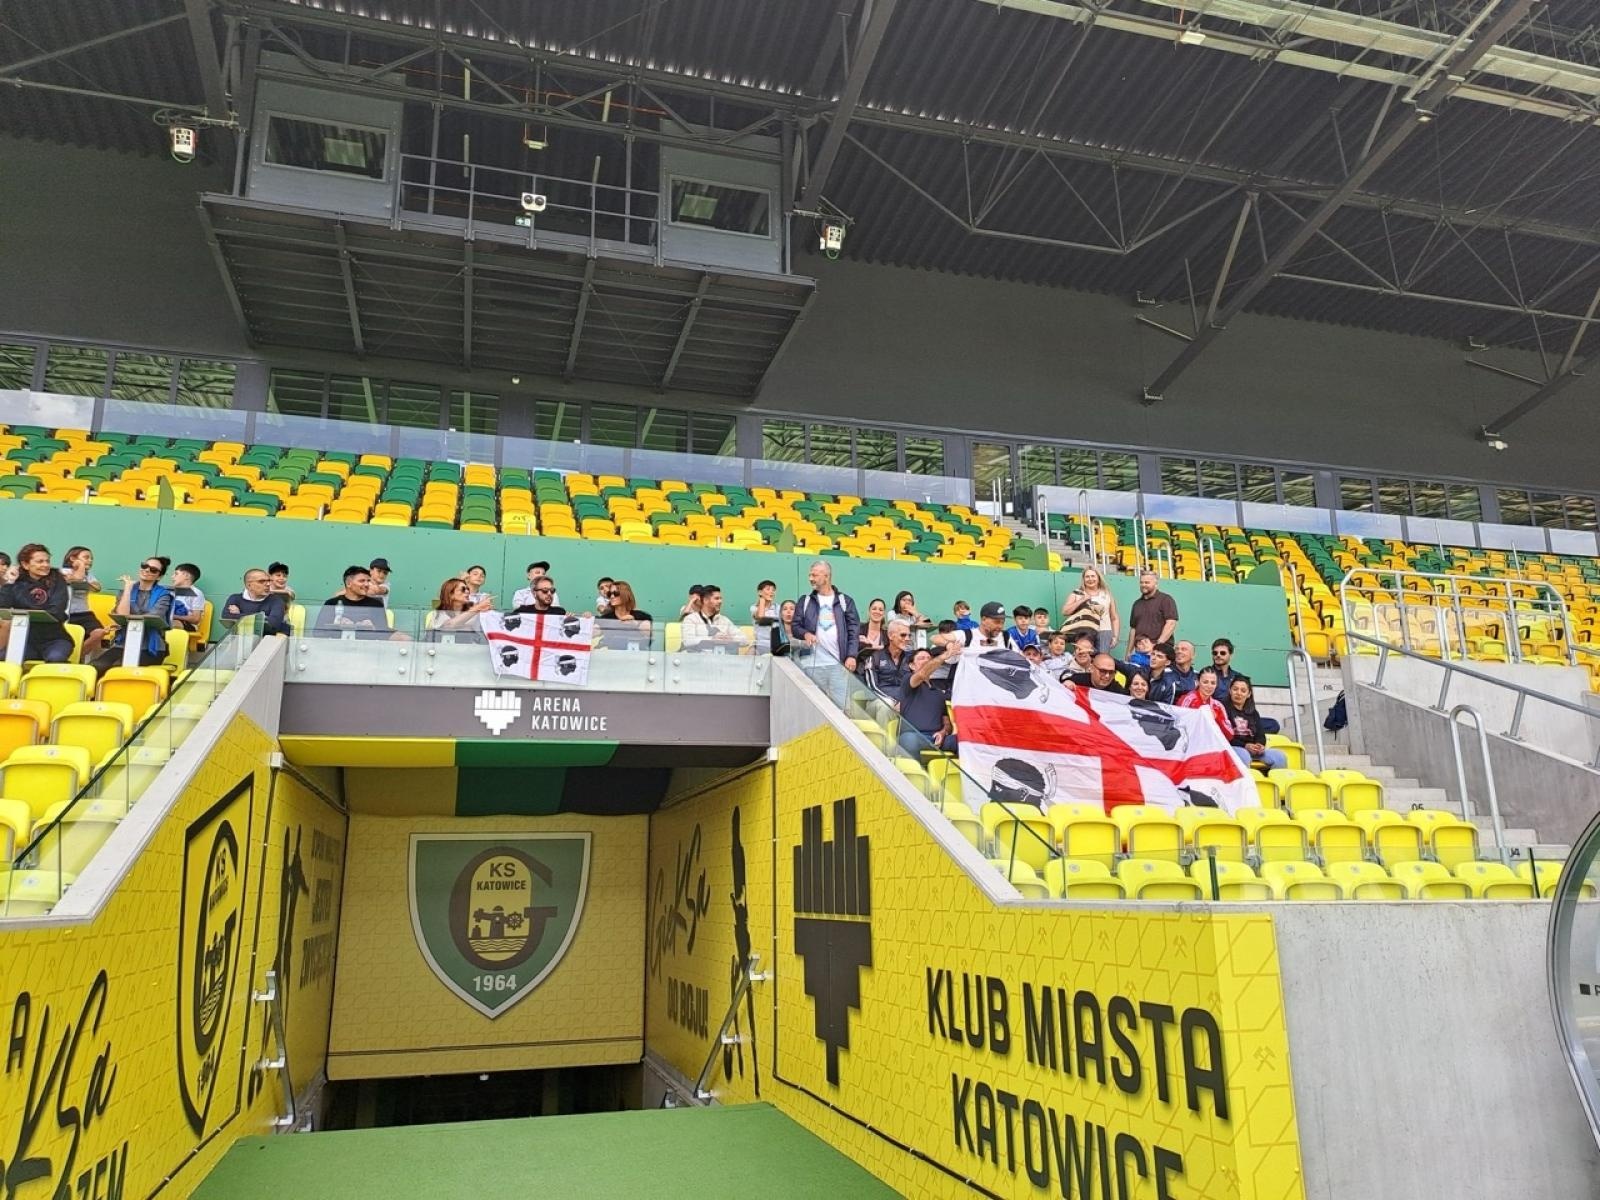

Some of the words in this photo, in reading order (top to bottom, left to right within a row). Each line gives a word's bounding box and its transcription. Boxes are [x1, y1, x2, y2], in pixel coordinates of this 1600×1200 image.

[533, 697, 581, 712] ARENA
[531, 715, 608, 731] KATOWICE
[489, 862, 517, 878] KS
[476, 880, 527, 891] KATOWICE
[472, 974, 518, 992] 1964
[667, 976, 679, 1023] DO
[926, 966, 1011, 1055] KLUB
[1022, 981, 1229, 1121] MIASTA
